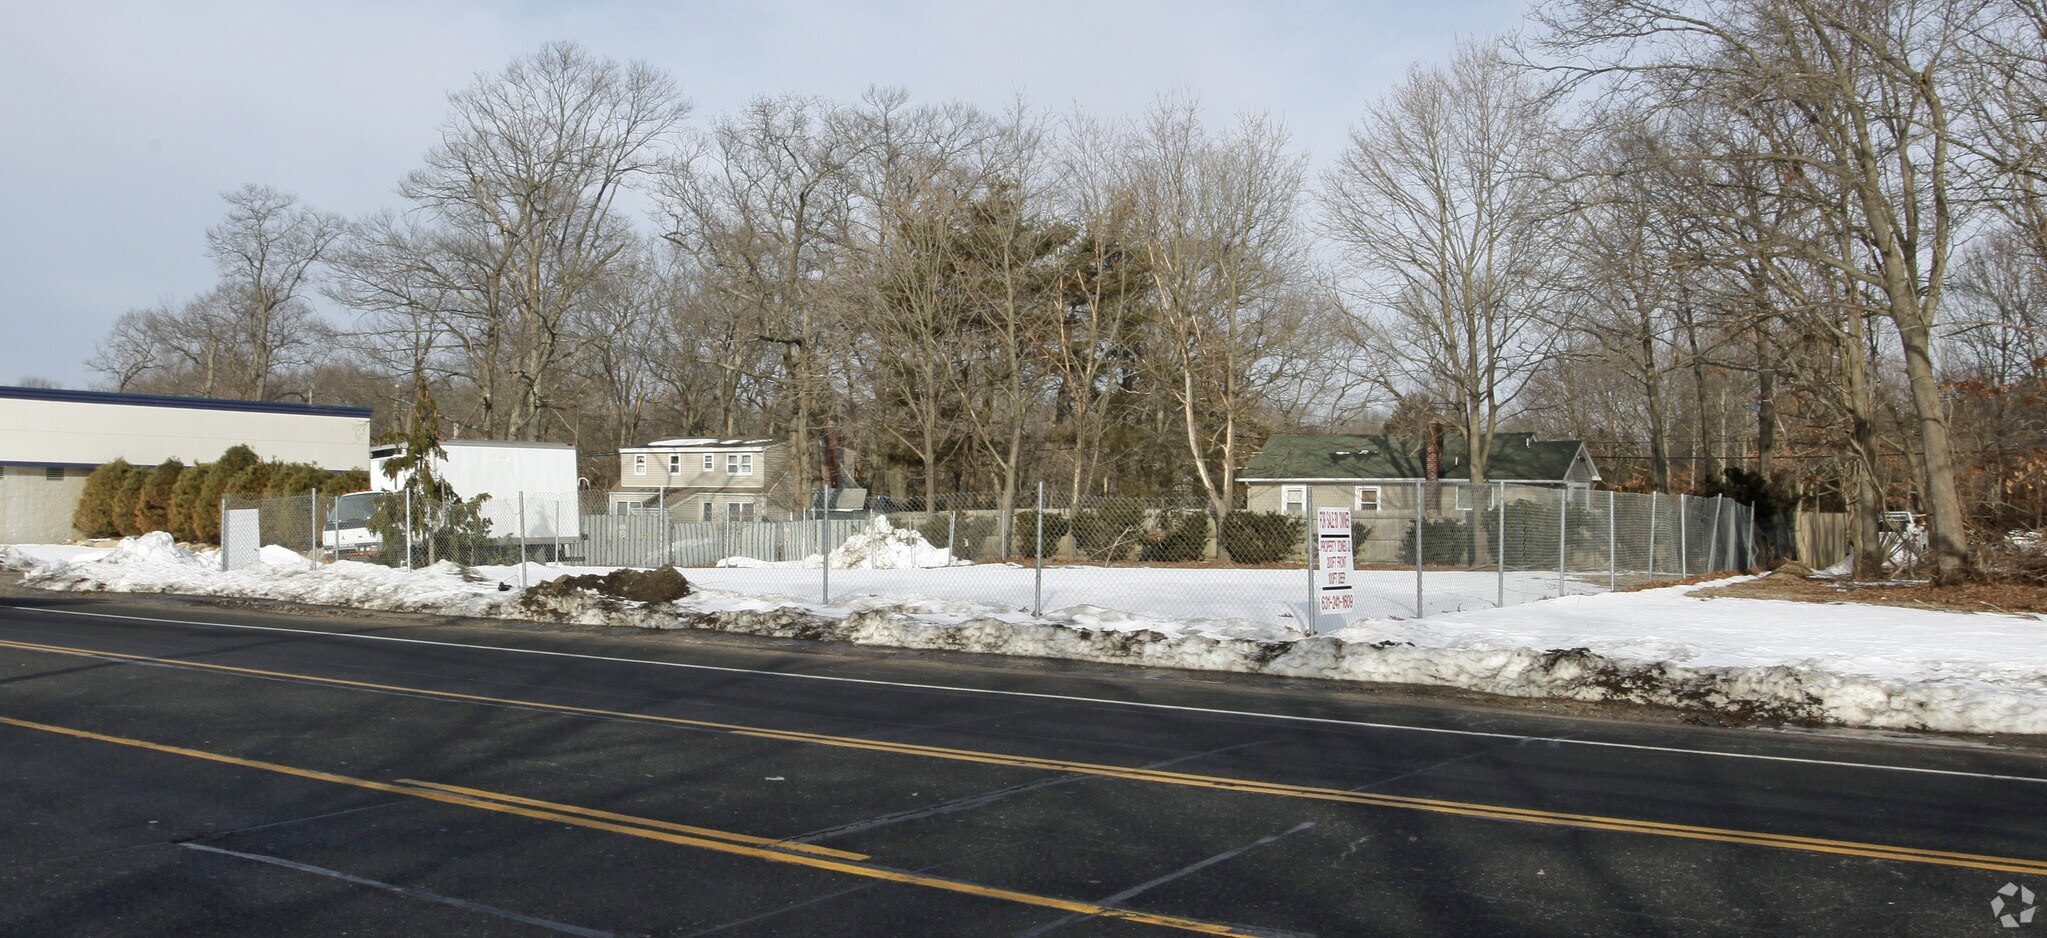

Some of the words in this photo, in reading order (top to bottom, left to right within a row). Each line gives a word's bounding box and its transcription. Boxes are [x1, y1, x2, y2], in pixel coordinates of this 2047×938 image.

[1339, 511, 1349, 528] OWNER
[1321, 539, 1336, 552] PROPERTY
[1337, 539, 1347, 552] ZONED
[1337, 556, 1346, 568] FRONT
